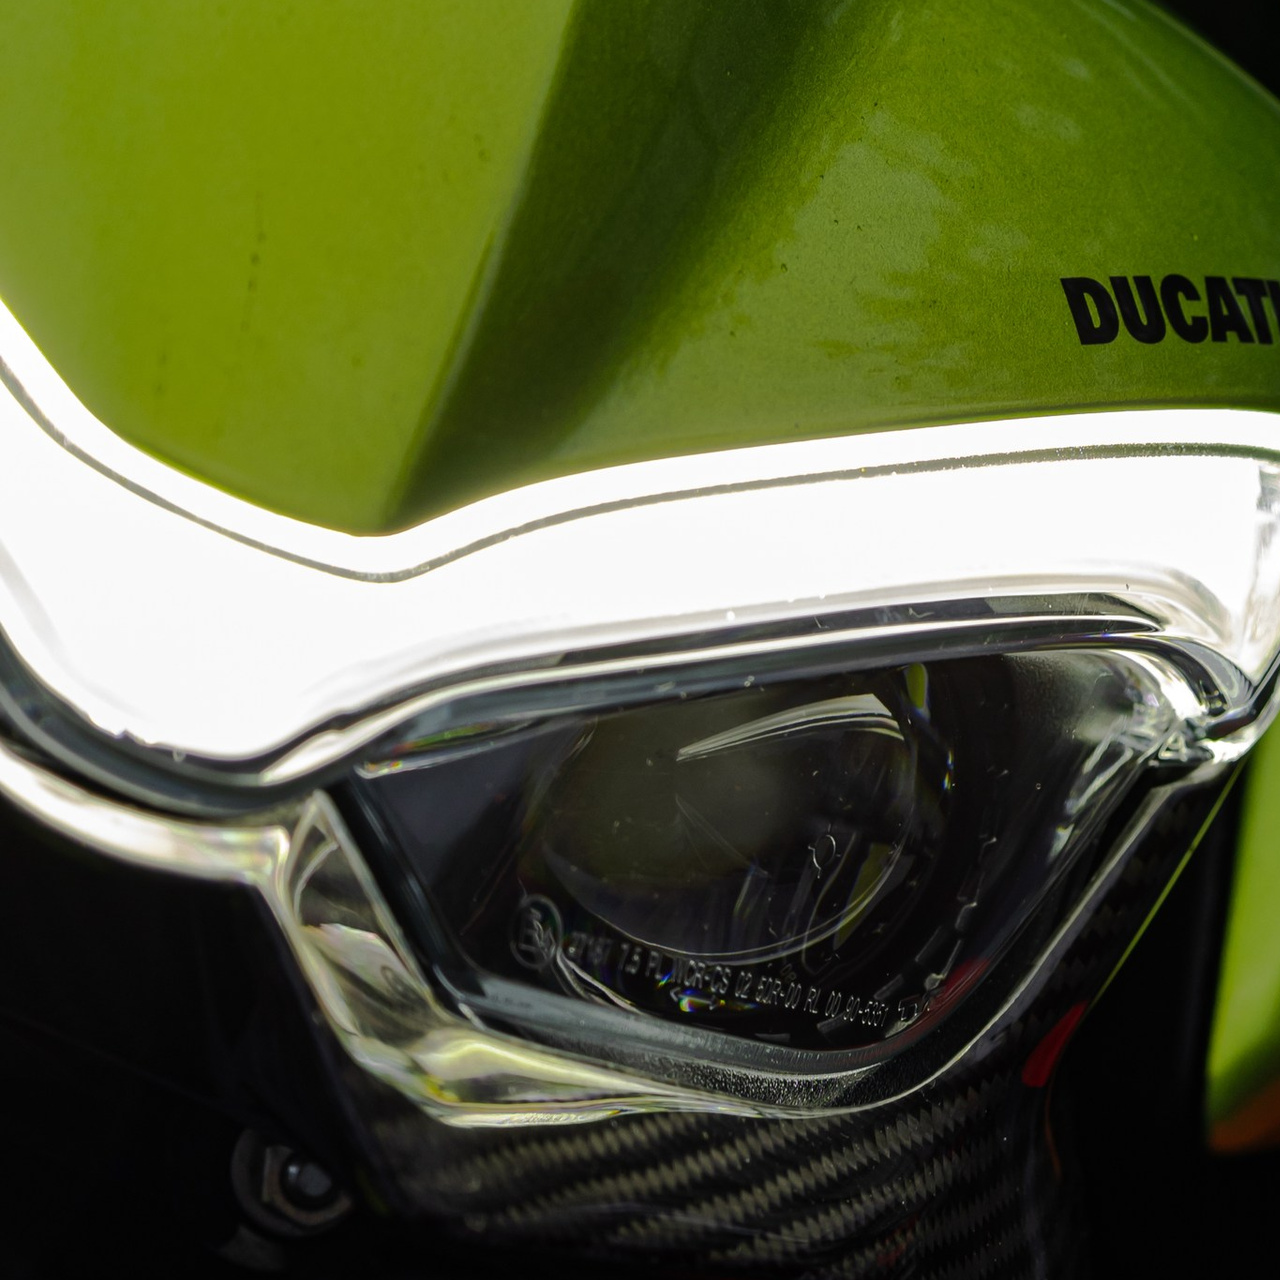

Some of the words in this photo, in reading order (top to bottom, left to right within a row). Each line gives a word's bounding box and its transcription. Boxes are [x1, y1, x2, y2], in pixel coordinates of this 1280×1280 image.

[644, 950, 665, 980] PL
[734, 970, 753, 999] 02
[755, 974, 801, 1010] 50R-00
[803, 985, 821, 1014] RL
[824, 988, 842, 1018] 00
[843, 994, 889, 1028] 90-5351
